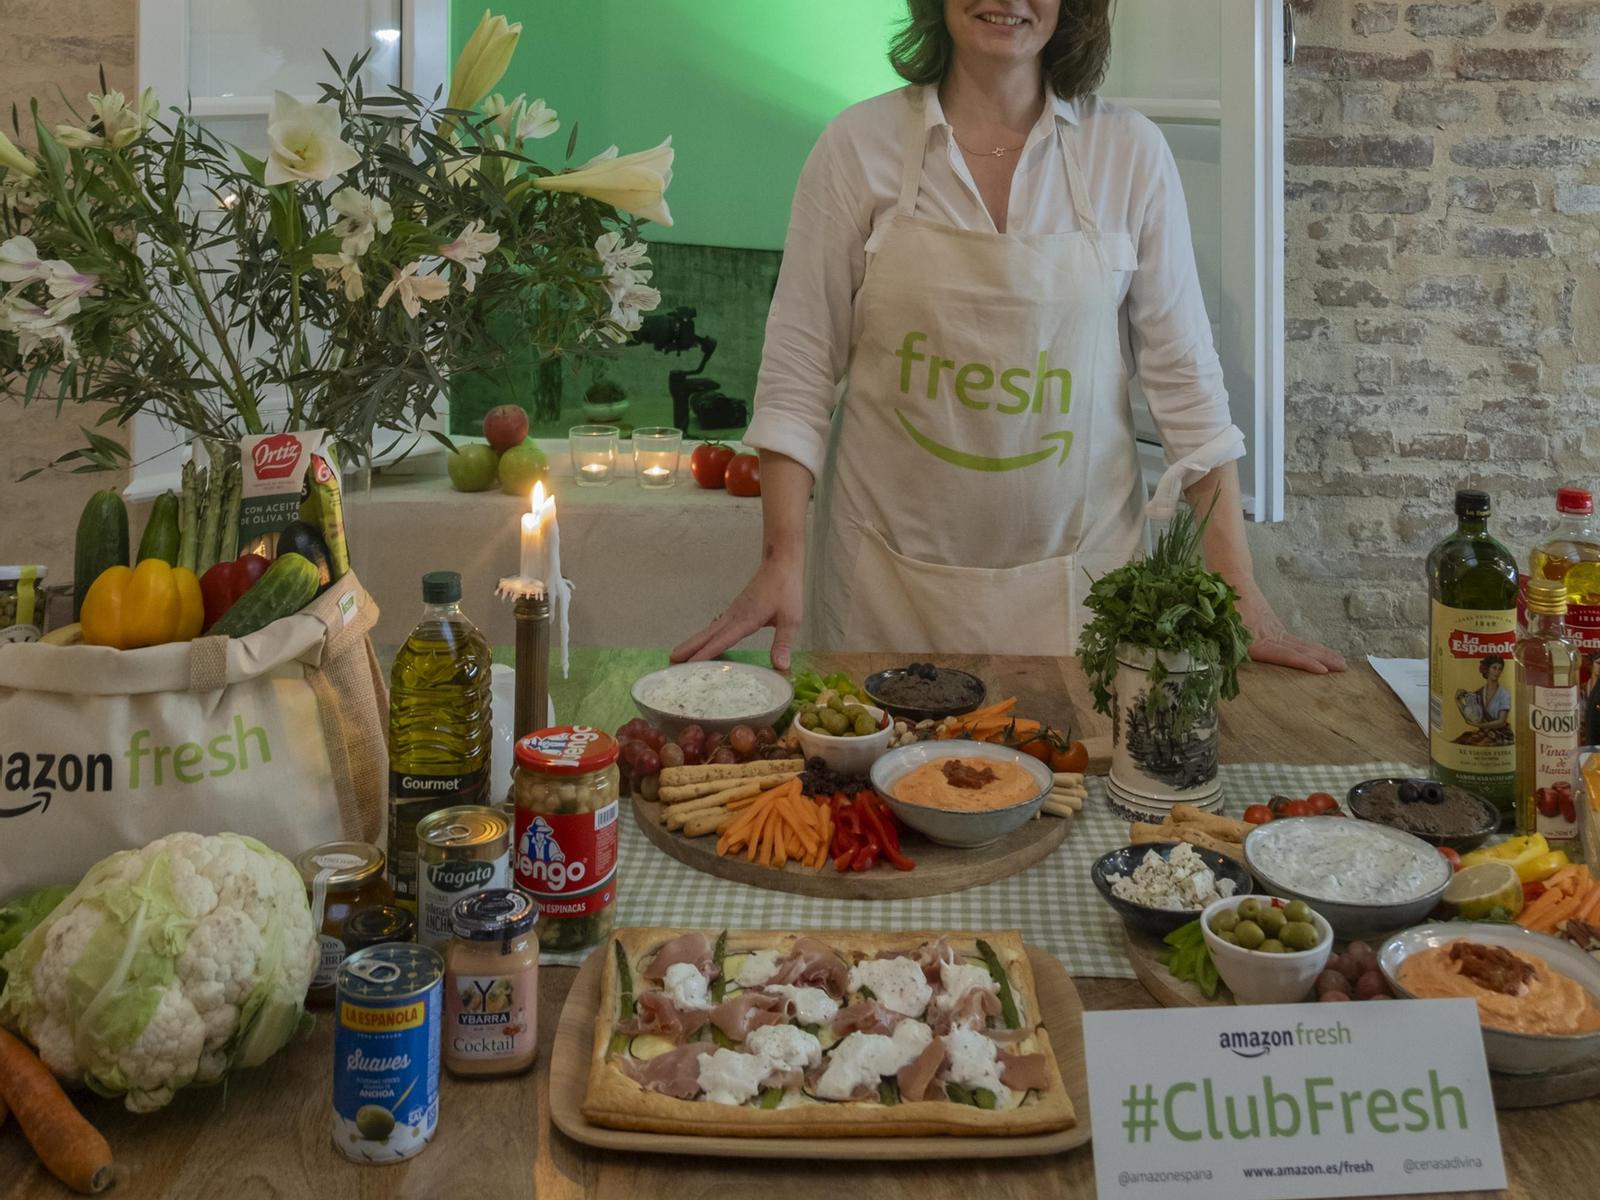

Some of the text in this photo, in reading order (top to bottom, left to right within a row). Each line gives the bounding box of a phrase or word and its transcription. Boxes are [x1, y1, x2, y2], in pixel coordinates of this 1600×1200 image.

[895, 331, 1072, 415] fresh
[254, 442, 299, 468] Ortiz
[244, 501, 300, 515] CON ACEITE
[241, 517, 250, 525] DE
[252, 514, 282, 524] OLIVA
[1463, 633, 1479, 645] La
[1566, 628, 1583, 639] La
[0, 715, 272, 792] azon fresh
[1539, 764, 1571, 775] Manza
[402, 776, 459, 790] Gourmet
[430, 863, 491, 888] Fragata
[546, 902, 586, 914] ESPINACAS
[474, 980, 496, 1013] Y
[346, 1006, 357, 1023] LA
[461, 1013, 508, 1025] YBARRA
[1219, 1021, 1352, 1049] amazon fresh
[453, 1035, 515, 1053] Cocktail
[347, 1048, 412, 1072] Suaves
[360, 1089, 395, 1099] ANCHOA
[1121, 1069, 1469, 1144] #ClubFresh
[1118, 1156, 1483, 1187] @amazonespana www.amazon.es/fresh @cenasadivina
